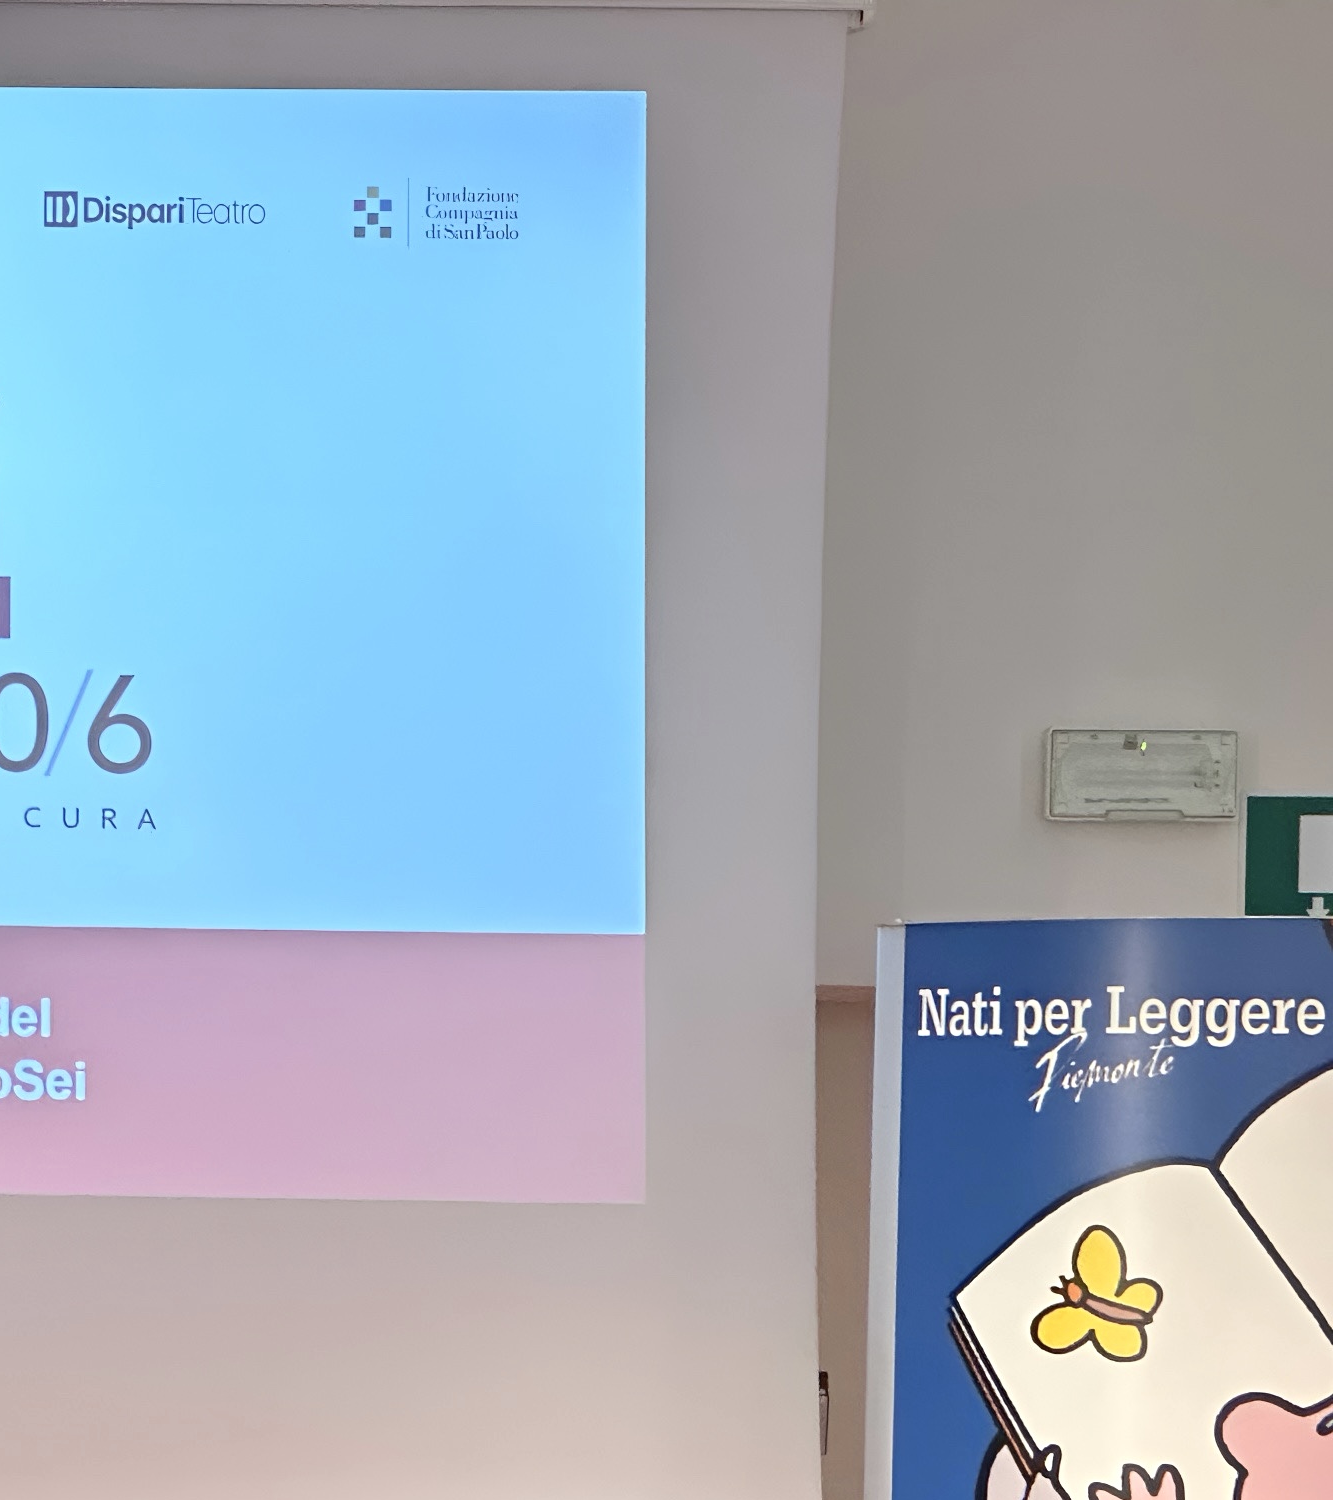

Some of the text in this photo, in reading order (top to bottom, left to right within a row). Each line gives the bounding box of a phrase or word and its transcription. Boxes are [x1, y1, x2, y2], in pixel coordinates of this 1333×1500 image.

[425, 185, 520, 203] Fondazione
[424, 203, 519, 223] Compagnia
[425, 223, 441, 240] di
[23, 805, 158, 832] CURA
[917, 984, 1326, 1048] Nati per Leggere
